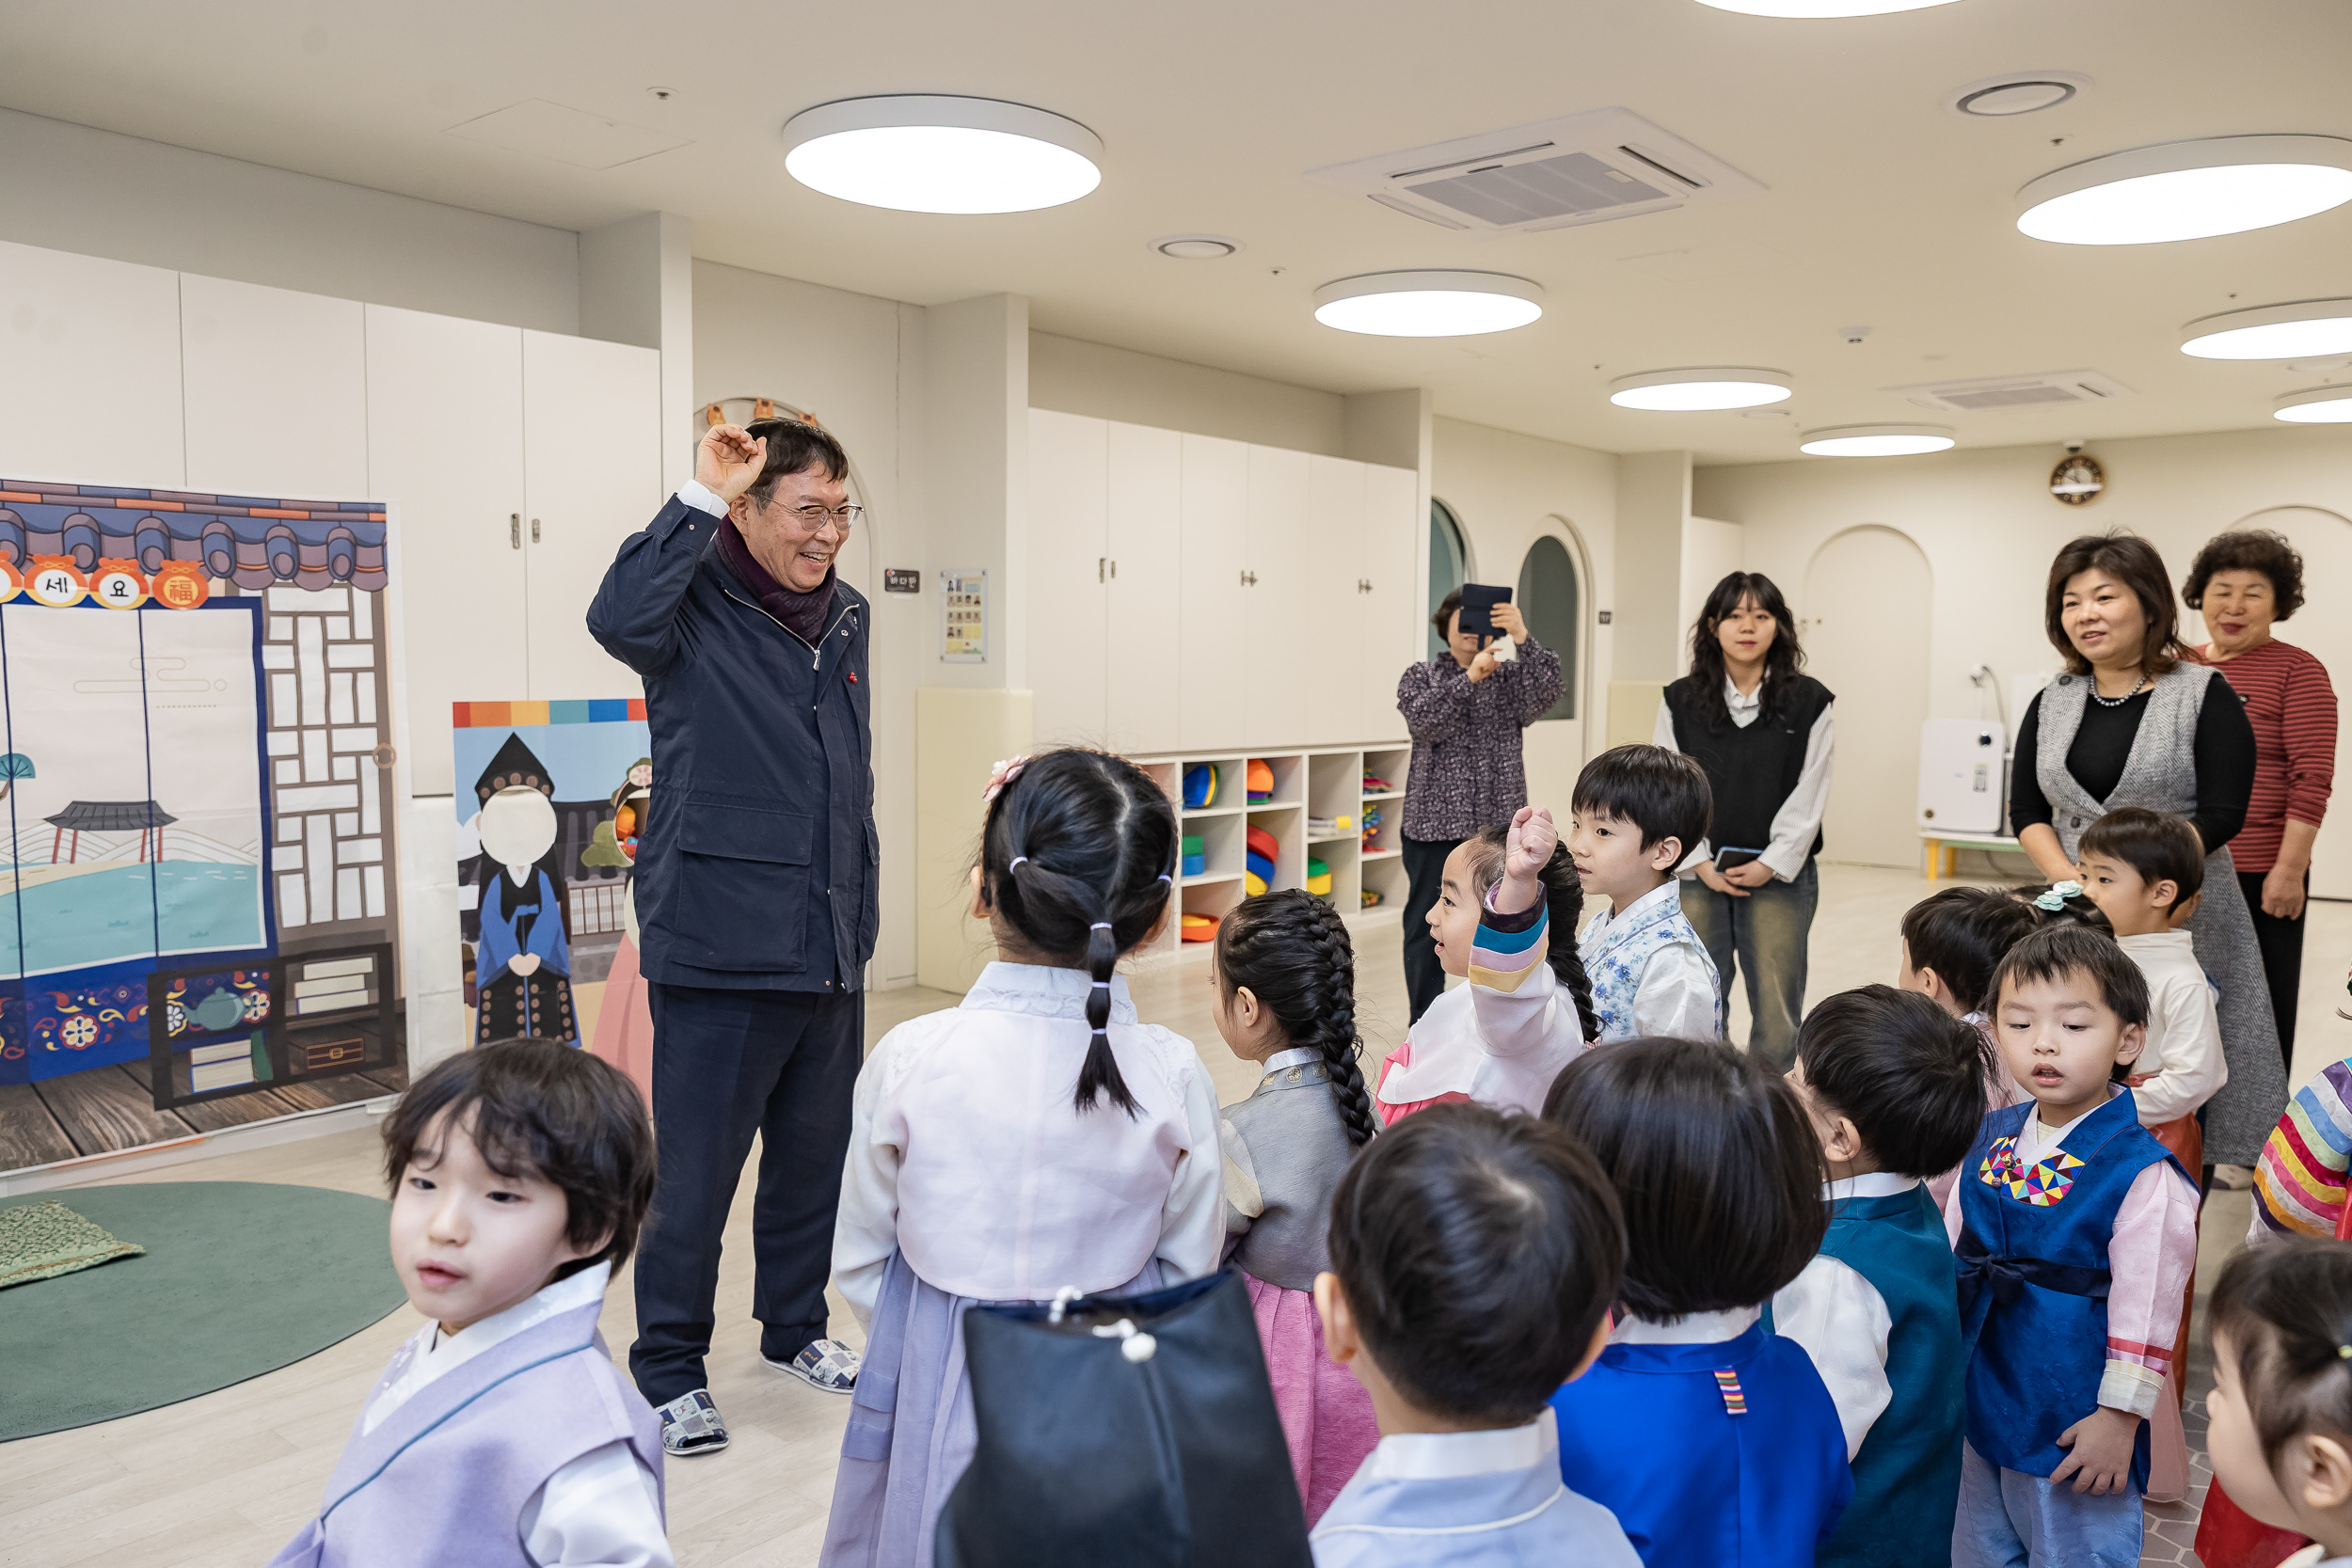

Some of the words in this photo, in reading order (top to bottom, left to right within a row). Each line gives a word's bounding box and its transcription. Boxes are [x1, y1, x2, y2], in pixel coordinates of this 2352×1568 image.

[45, 577, 69, 594] 세
[109, 580, 129, 597] 요
[168, 579, 194, 603] 福
